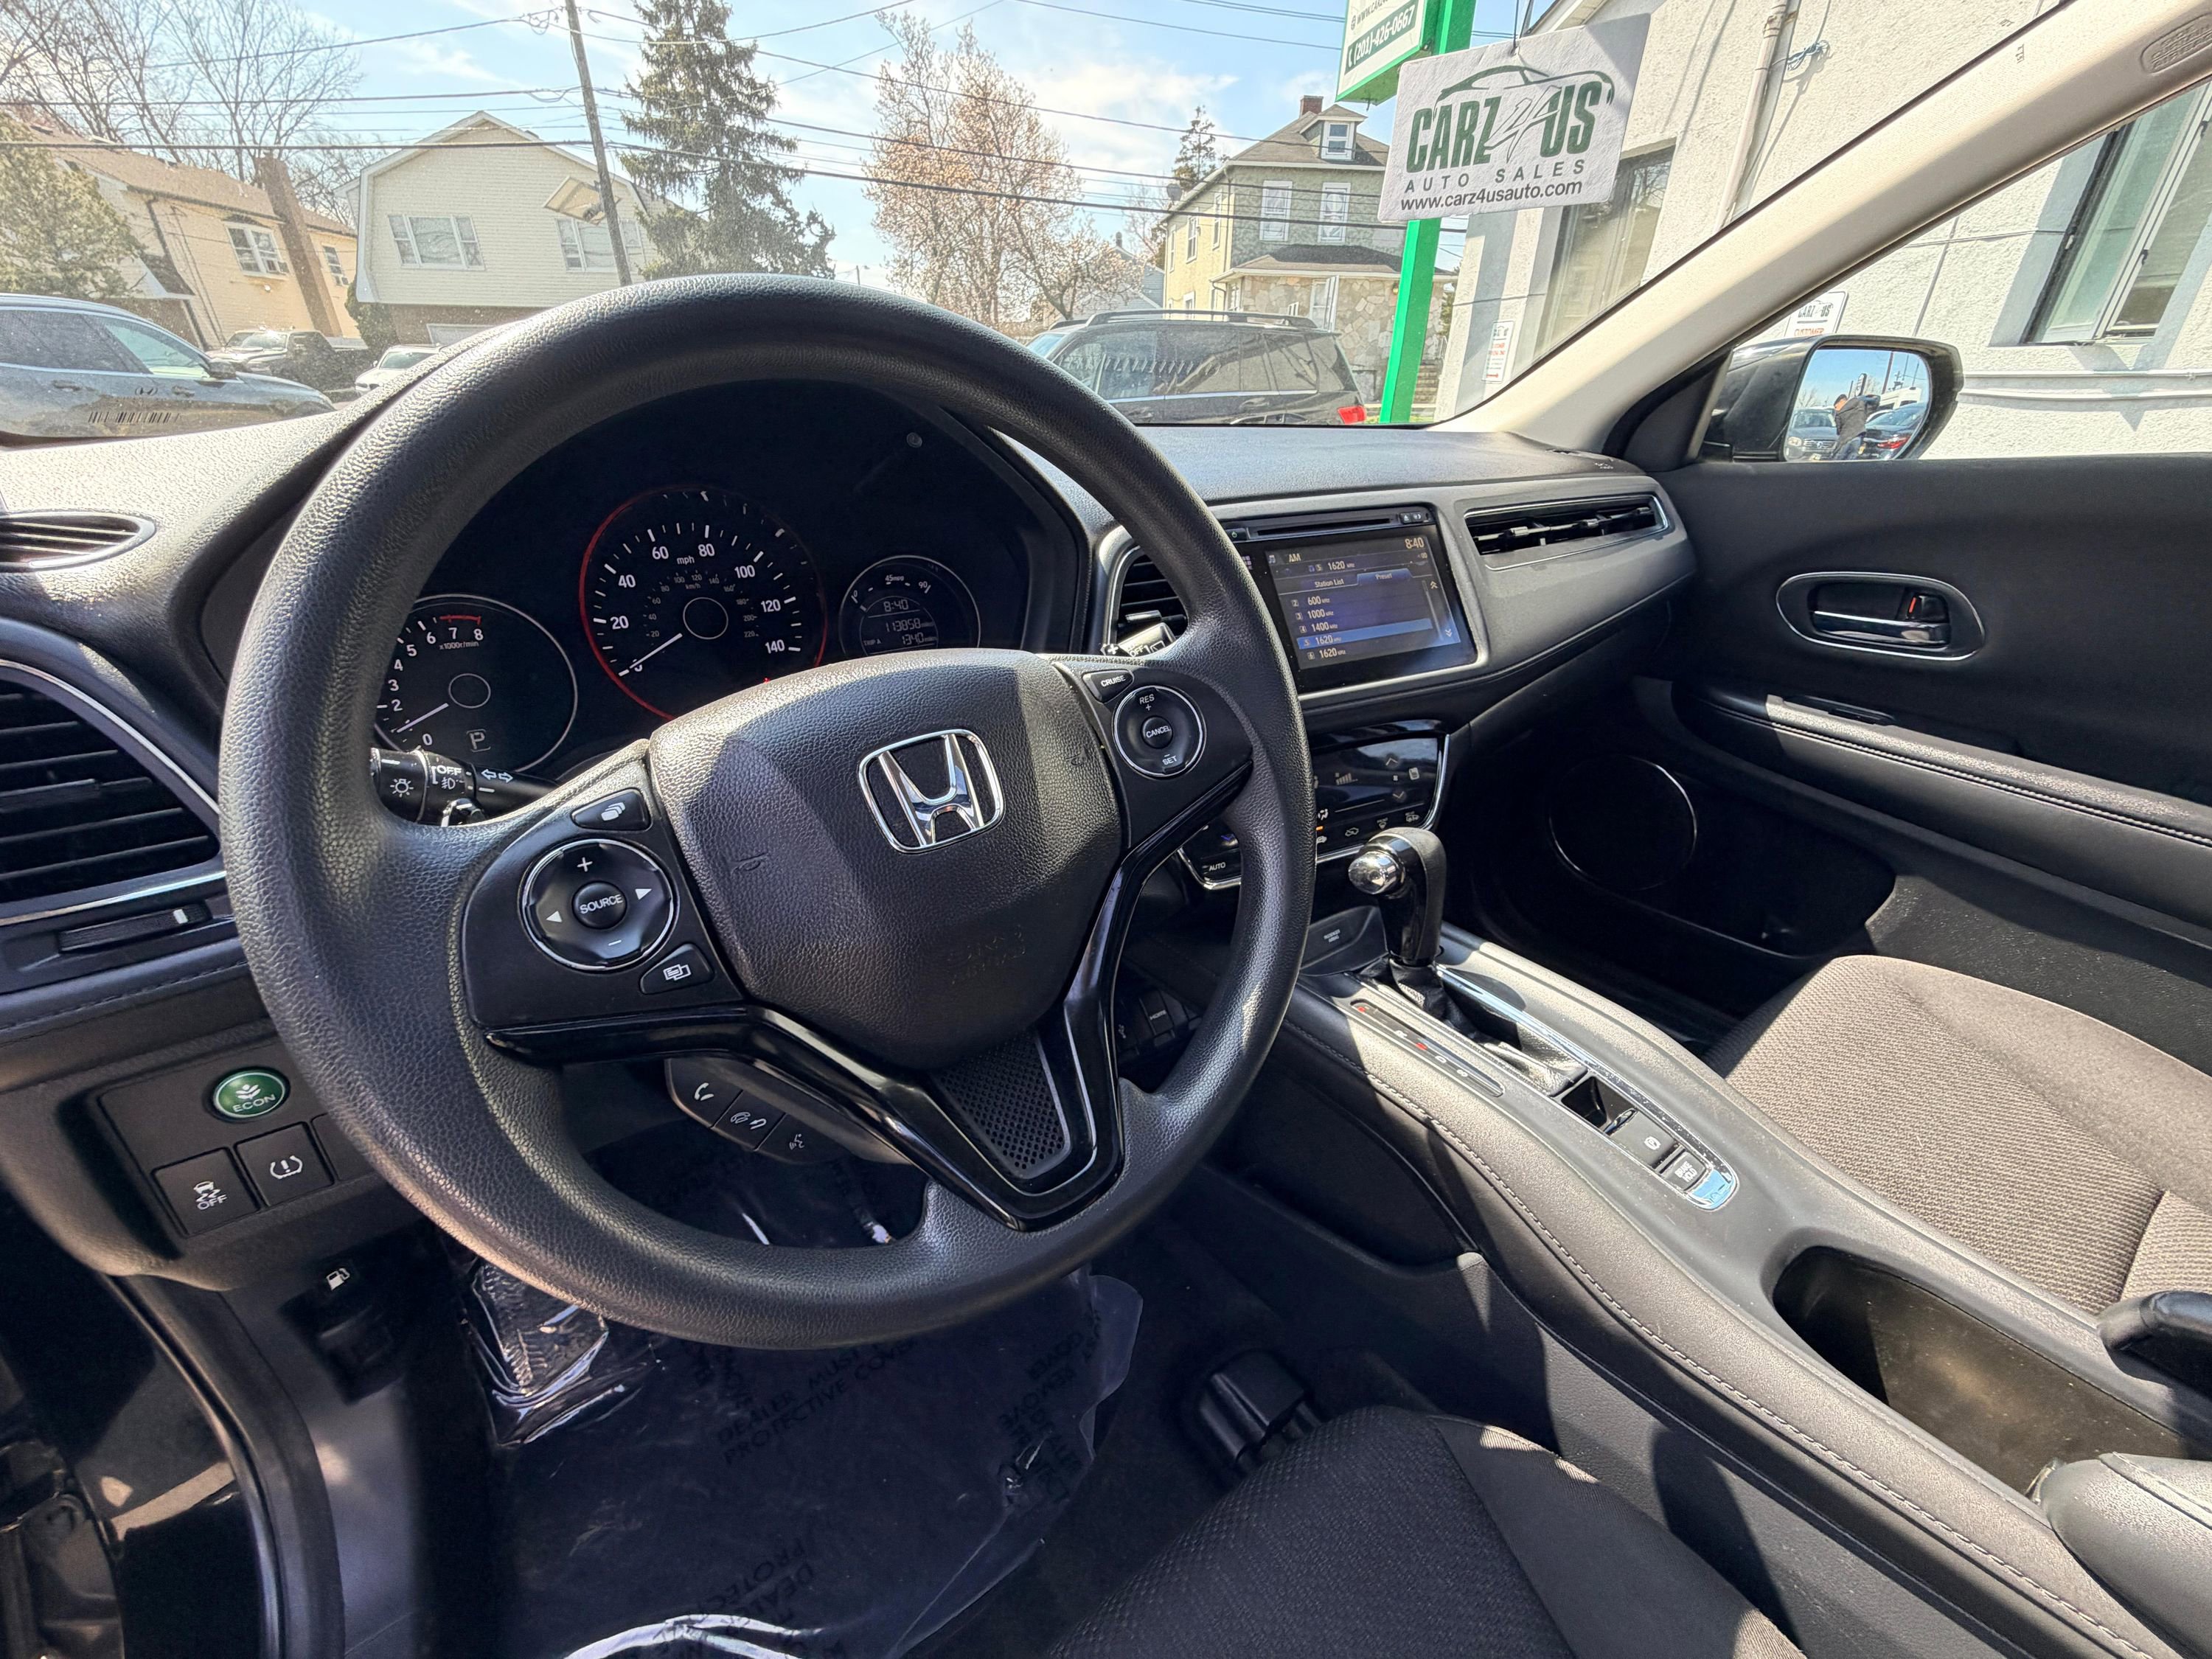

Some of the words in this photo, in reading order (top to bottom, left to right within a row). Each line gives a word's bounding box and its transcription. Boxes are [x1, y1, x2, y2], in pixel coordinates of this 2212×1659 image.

[1405, 173, 1470, 193] AUTO
[1495, 159, 1585, 184] SALES
[1401, 181, 1582, 212] www.carz4usauto.com
[1405, 537, 1425, 549] 8:40
[652, 546, 669, 560] 60
[698, 543, 715, 557] 80
[677, 555, 695, 566] mph
[1288, 553, 1301, 563] AM
[734, 565, 756, 579] 100
[1327, 560, 1346, 571] 1620
[618, 574, 636, 588] 40
[918, 581, 928, 589] 90
[1314, 580, 1334, 588] Station
[1334, 577, 1345, 587] List
[760, 599, 782, 613] 120
[883, 599, 908, 613] 8:40
[1307, 596, 1322, 606] 600
[1307, 609, 1326, 619] 1000
[610, 616, 630, 630] 20
[886, 618, 921, 633] 113858
[1311, 622, 1329, 633] 1400
[426, 632, 437, 644] 6
[448, 627, 458, 639] 7
[473, 628, 484, 641] 8
[765, 639, 786, 654] 140
[1315, 635, 1333, 645] 1620
[406, 644, 417, 657] 5
[1130, 644, 1144, 657] OFF
[1319, 648, 1338, 658] 1620
[394, 658, 404, 672] 4
[388, 678, 400, 692] 3
[1101, 675, 1126, 687] CRUISE
[391, 699, 403, 712] 2
[1139, 693, 1155, 705] RES
[1146, 726, 1172, 738] CANCEL
[422, 733, 434, 746] 0
[468, 731, 486, 751] P
[1162, 755, 1178, 766] SET
[437, 765, 463, 776] OFF
[1209, 861, 1226, 872] AUTO
[580, 894, 624, 914] SOURCE
[232, 1092, 276, 1114] ECON
[1674, 1161, 1694, 1178] BRAKE
[1685, 1167, 1698, 1183] HOLD
[196, 1194, 228, 1211] OFF
